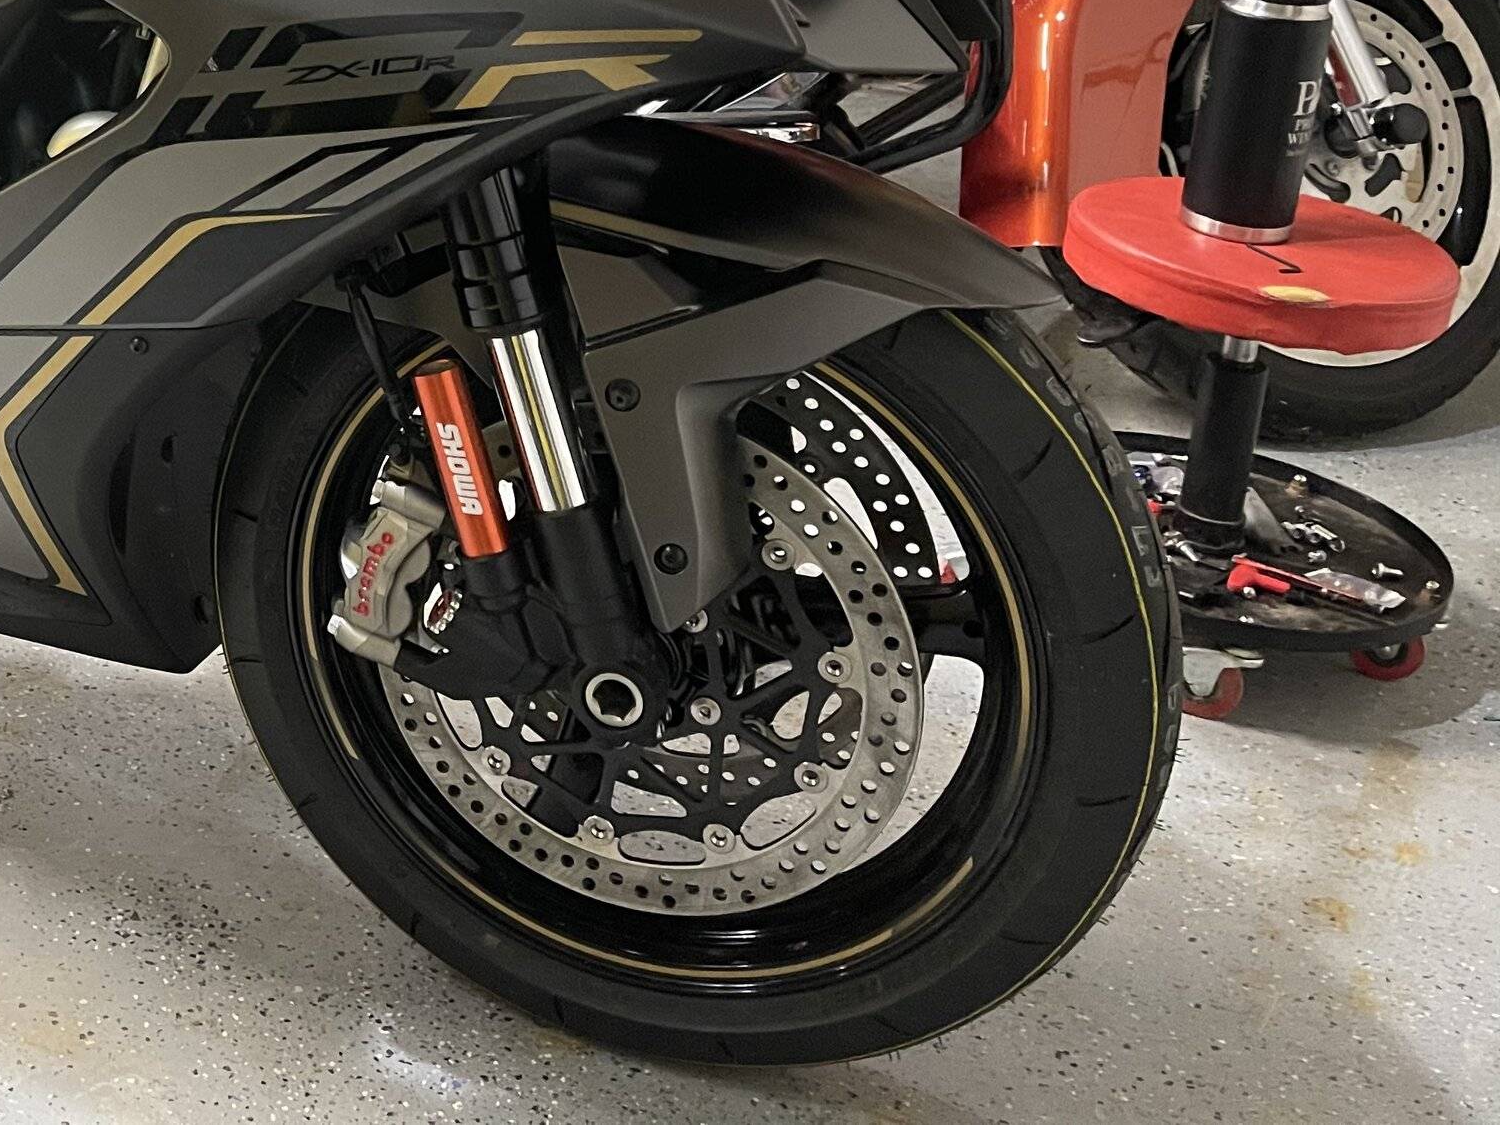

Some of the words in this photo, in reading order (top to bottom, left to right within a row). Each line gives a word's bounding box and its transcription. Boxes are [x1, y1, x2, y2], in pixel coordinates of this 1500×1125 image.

[282, 54, 457, 87] ZX-10R
[436, 422, 484, 516] SHOWA
[353, 531, 394, 617] brembo
